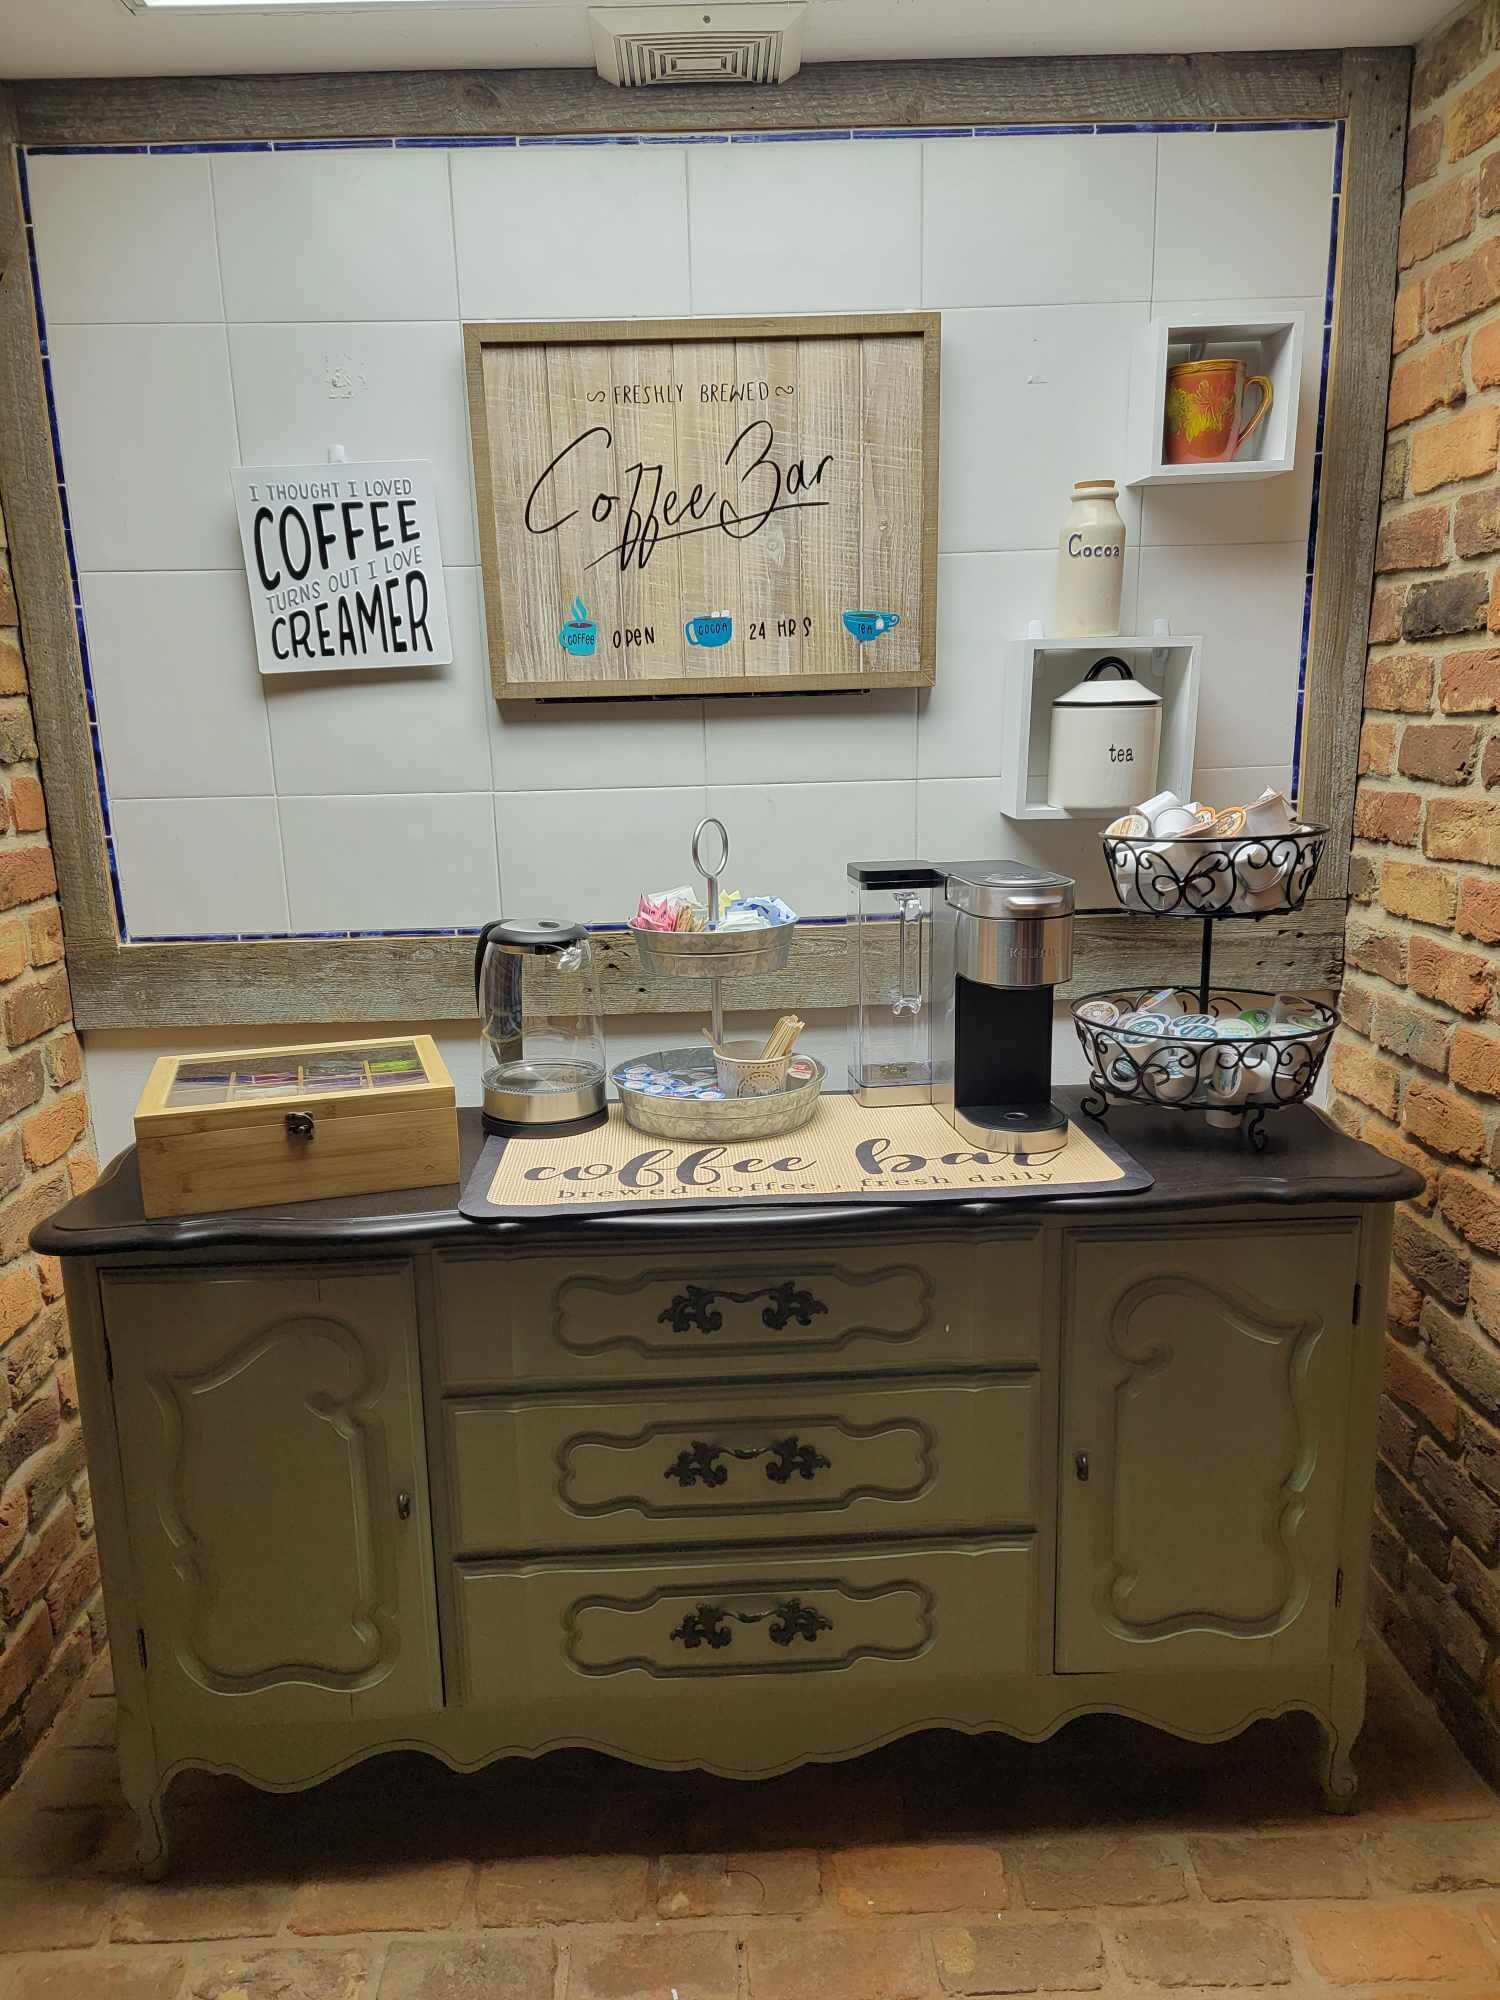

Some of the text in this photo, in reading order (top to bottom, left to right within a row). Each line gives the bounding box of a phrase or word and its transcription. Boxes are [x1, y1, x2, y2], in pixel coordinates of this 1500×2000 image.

[613, 381, 769, 404] FRESHLY BREWED
[249, 479, 412, 501] I THOUGHT I LOVED
[525, 419, 834, 571] Coffee Bar
[253, 499, 421, 591] COFFEE
[1068, 533, 1120, 557] Cocoa
[266, 545, 423, 614] TURNS OUT I LOVE
[271, 569, 433, 660] CREAMER
[749, 621, 766, 640] 24
[777, 616, 812, 637] HRS
[1108, 743, 1134, 762] tea
[523, 1146, 817, 1189] coffee
[557, 1185, 689, 1199] brewed
[860, 1174, 951, 1187] fresh
[968, 1171, 1056, 1184] daily
